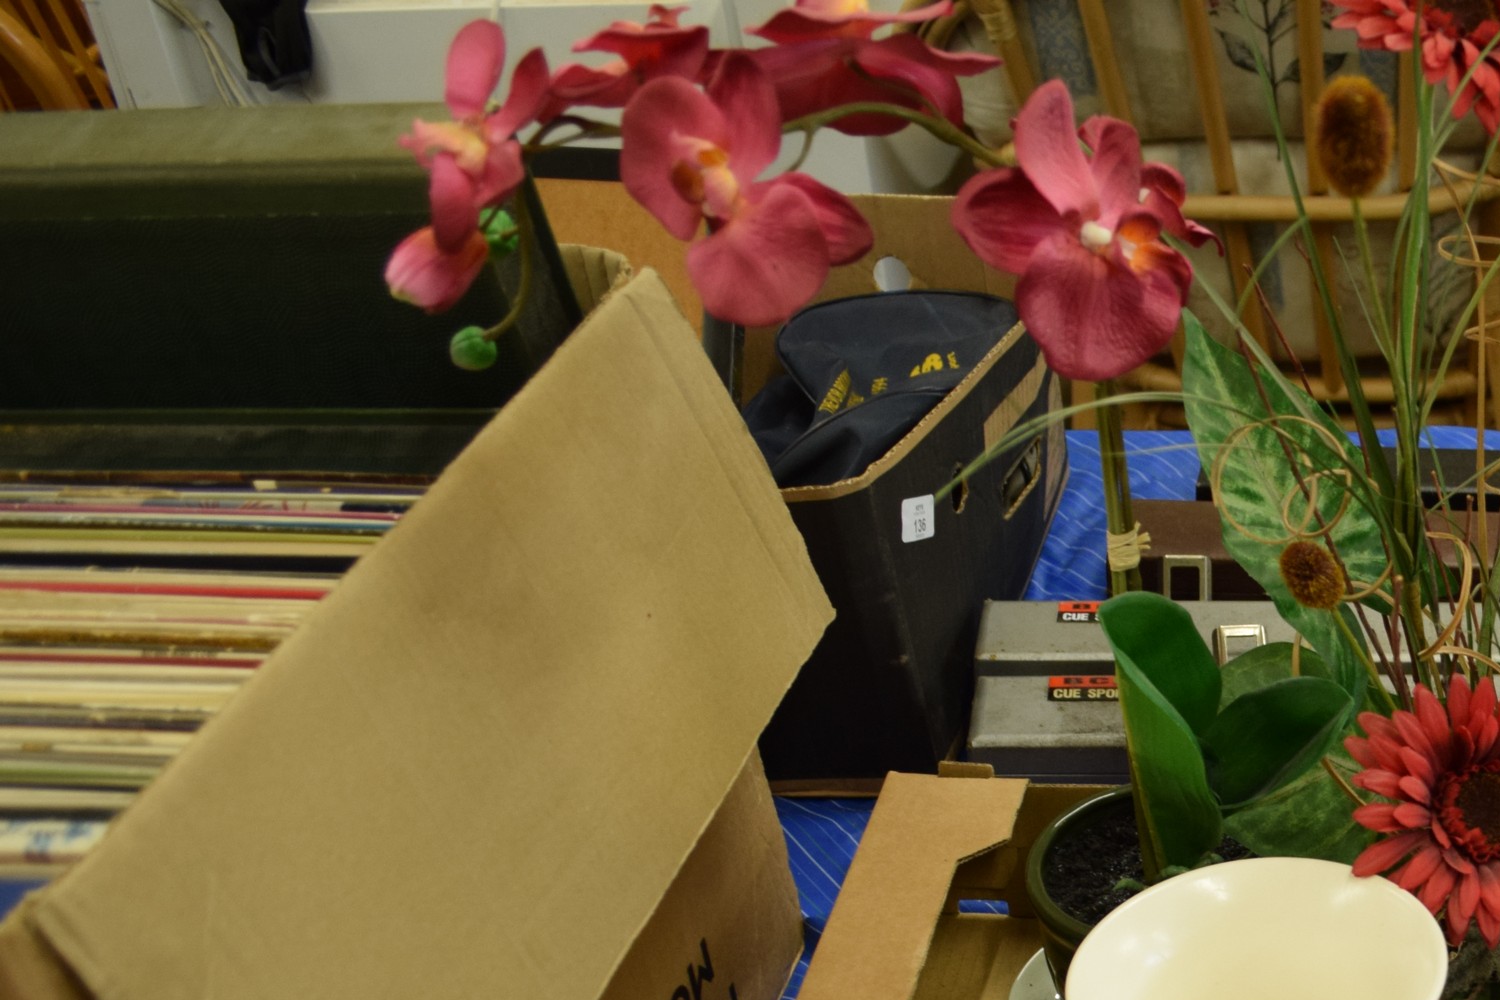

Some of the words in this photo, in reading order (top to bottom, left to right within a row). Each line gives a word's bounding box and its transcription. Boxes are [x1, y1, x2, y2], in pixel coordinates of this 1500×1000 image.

[914, 518, 927, 534] 136
[1062, 612, 1090, 621] CUE
[1053, 688, 1082, 699] CUE
